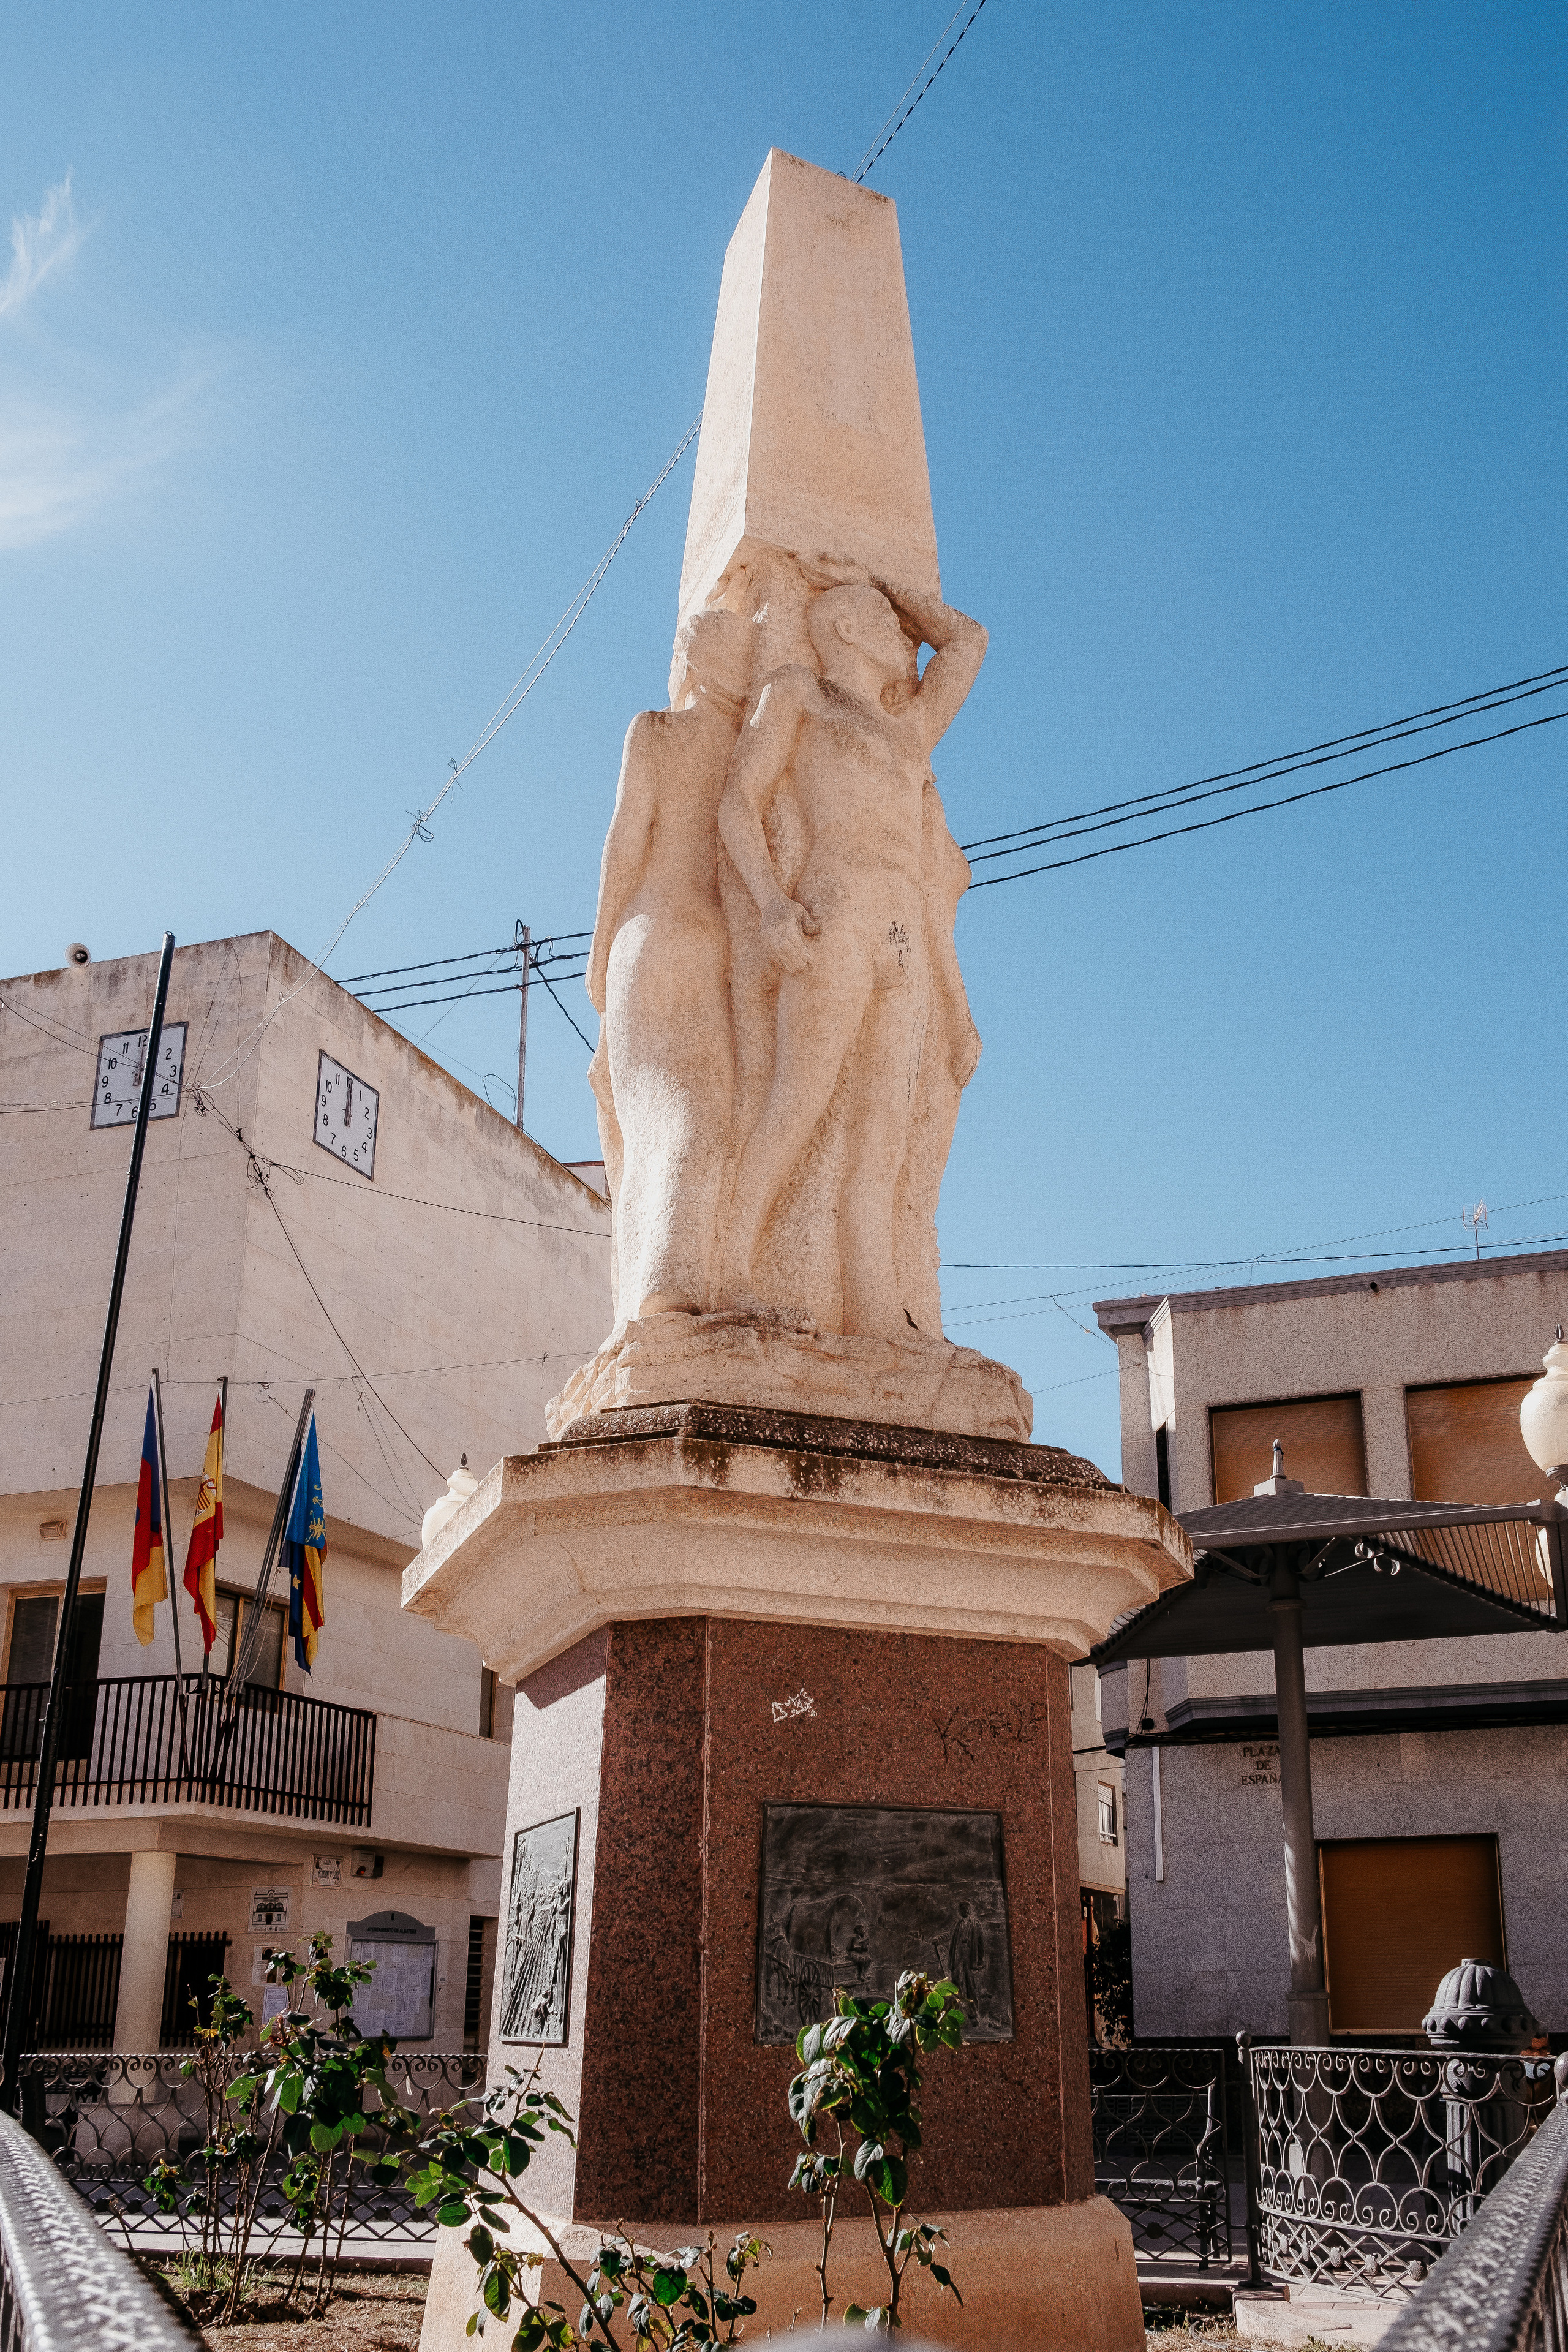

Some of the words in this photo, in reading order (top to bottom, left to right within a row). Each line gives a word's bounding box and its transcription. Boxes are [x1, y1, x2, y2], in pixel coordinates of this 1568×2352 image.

[138, 1035, 148, 1047] 12
[123, 1042, 129, 1055] 11
[165, 1048, 173, 1060] 2
[108, 1057, 117, 1070] 10
[169, 1065, 177, 1077] 3
[102, 1076, 109, 1088] 9
[336, 1072, 341, 1086] 11
[161, 1083, 169, 1095] 4
[325, 1079, 332, 1093] 10
[104, 1092, 111, 1104] 8
[321, 1095, 326, 1107] 9
[116, 1104, 123, 1116] 7
[131, 1106, 138, 1118] 6
[364, 1107, 369, 1120] 2
[323, 1114, 328, 1126] 8
[331, 1132, 336, 1144] 7
[368, 1127, 372, 1139] 3
[341, 1145, 347, 1158] 6
[361, 1142, 368, 1154] 4
[353, 1148, 359, 1161] 5
[1242, 1745, 1280, 1758] PLAZA
[1256, 1760, 1272, 1771] DE
